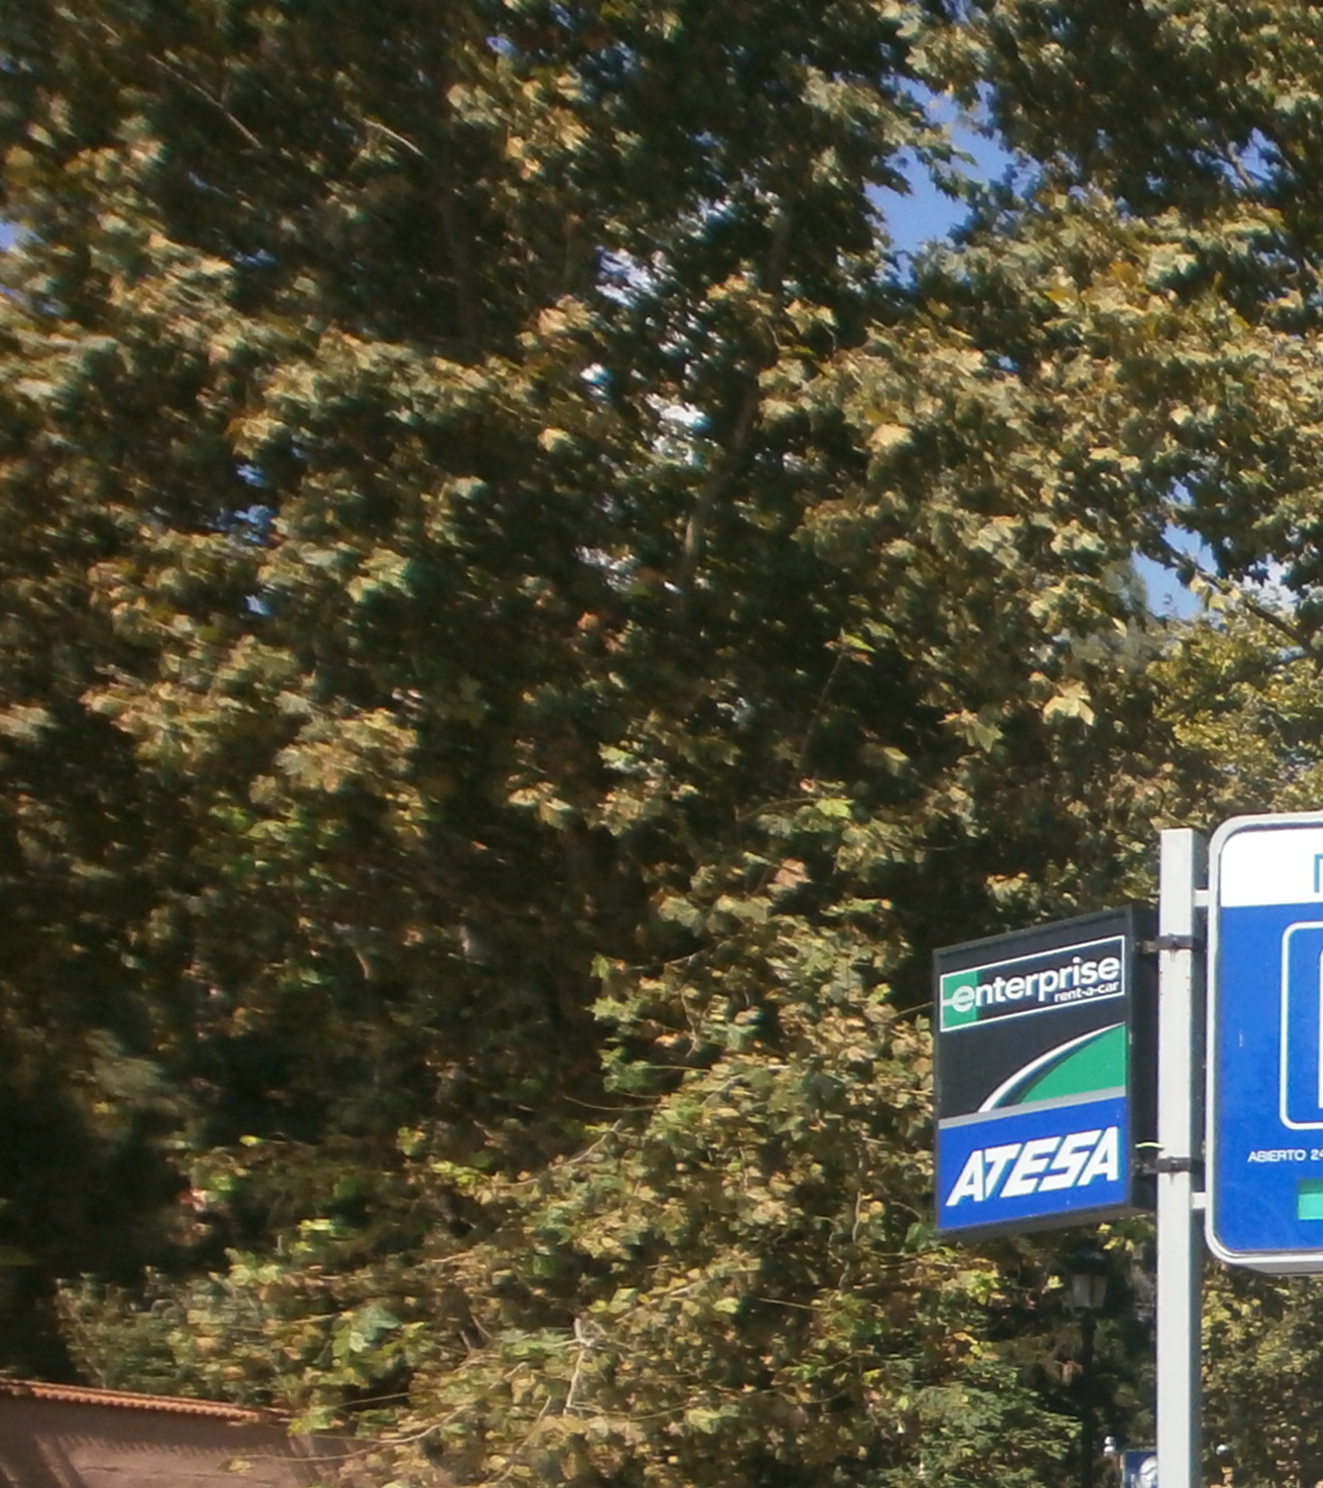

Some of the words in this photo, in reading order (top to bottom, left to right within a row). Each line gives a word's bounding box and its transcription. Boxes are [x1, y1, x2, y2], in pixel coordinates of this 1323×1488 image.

[949, 956, 1120, 1013] enterprise
[1054, 980, 1120, 1003] rent-a-car
[946, 1125, 1121, 1208] ATESA
[1247, 1149, 1306, 1163] ABIERTO
